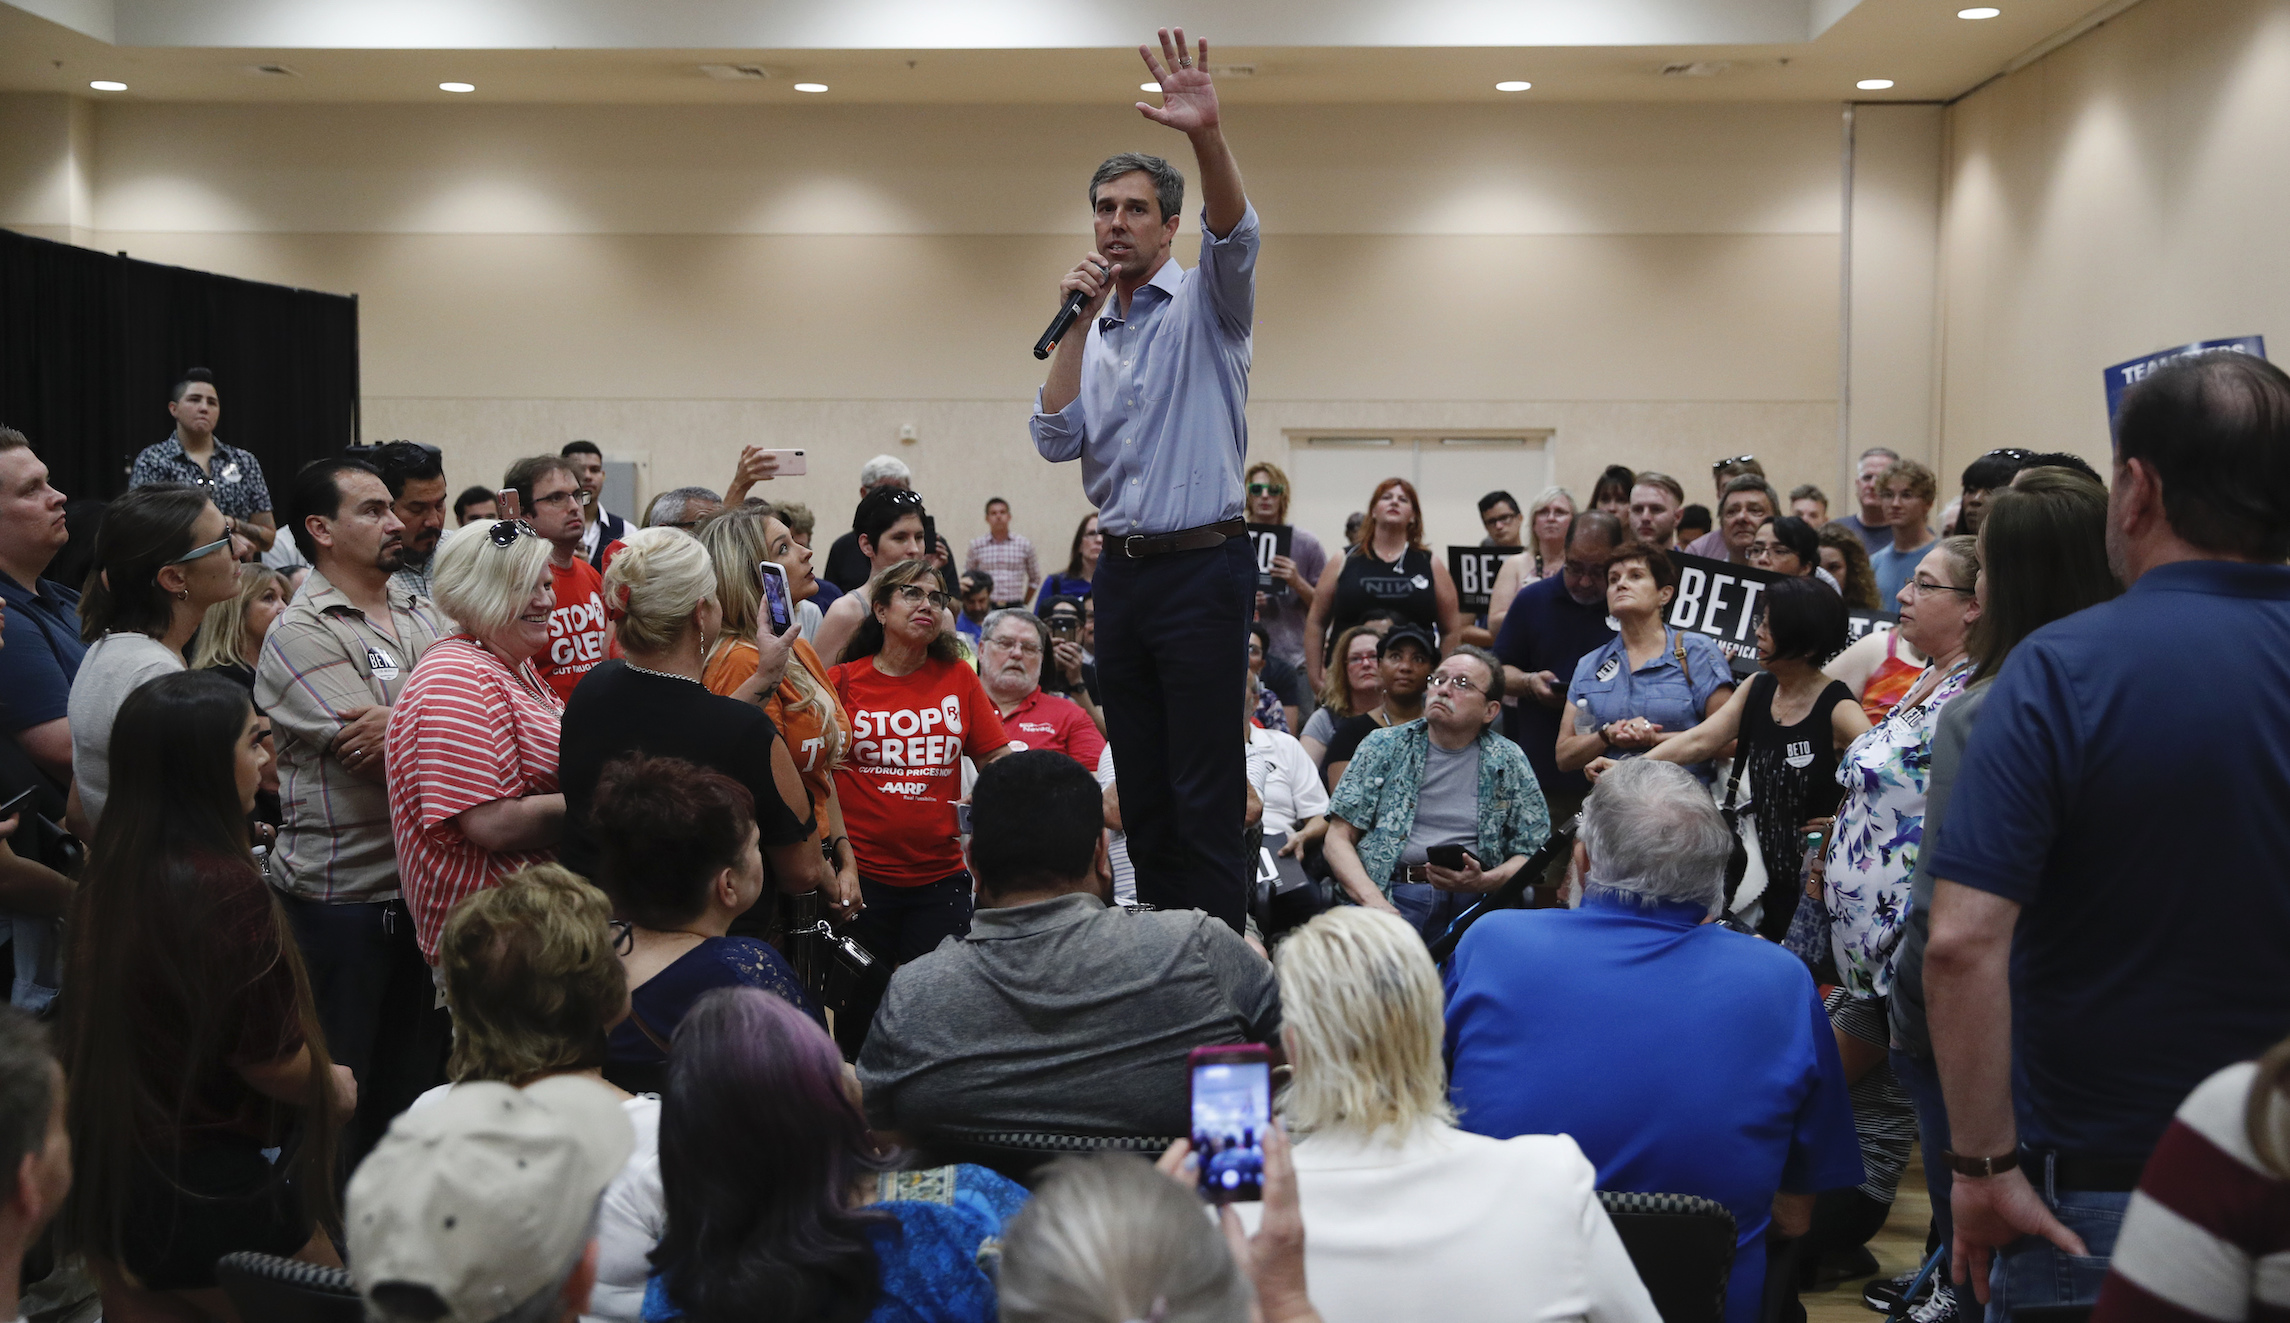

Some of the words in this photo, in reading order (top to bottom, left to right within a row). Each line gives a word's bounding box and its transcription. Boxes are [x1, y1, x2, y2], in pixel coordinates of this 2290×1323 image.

[1669, 566, 1766, 641] BET
[1596, 659, 1616, 680] BETO
[853, 707, 942, 739] STOP
[853, 735, 962, 767] GREED
[1786, 740, 1811, 757] BETO
[875, 766, 904, 776] DRUG
[906, 768, 939, 777] PRICES
[877, 782, 927, 795] AARP
